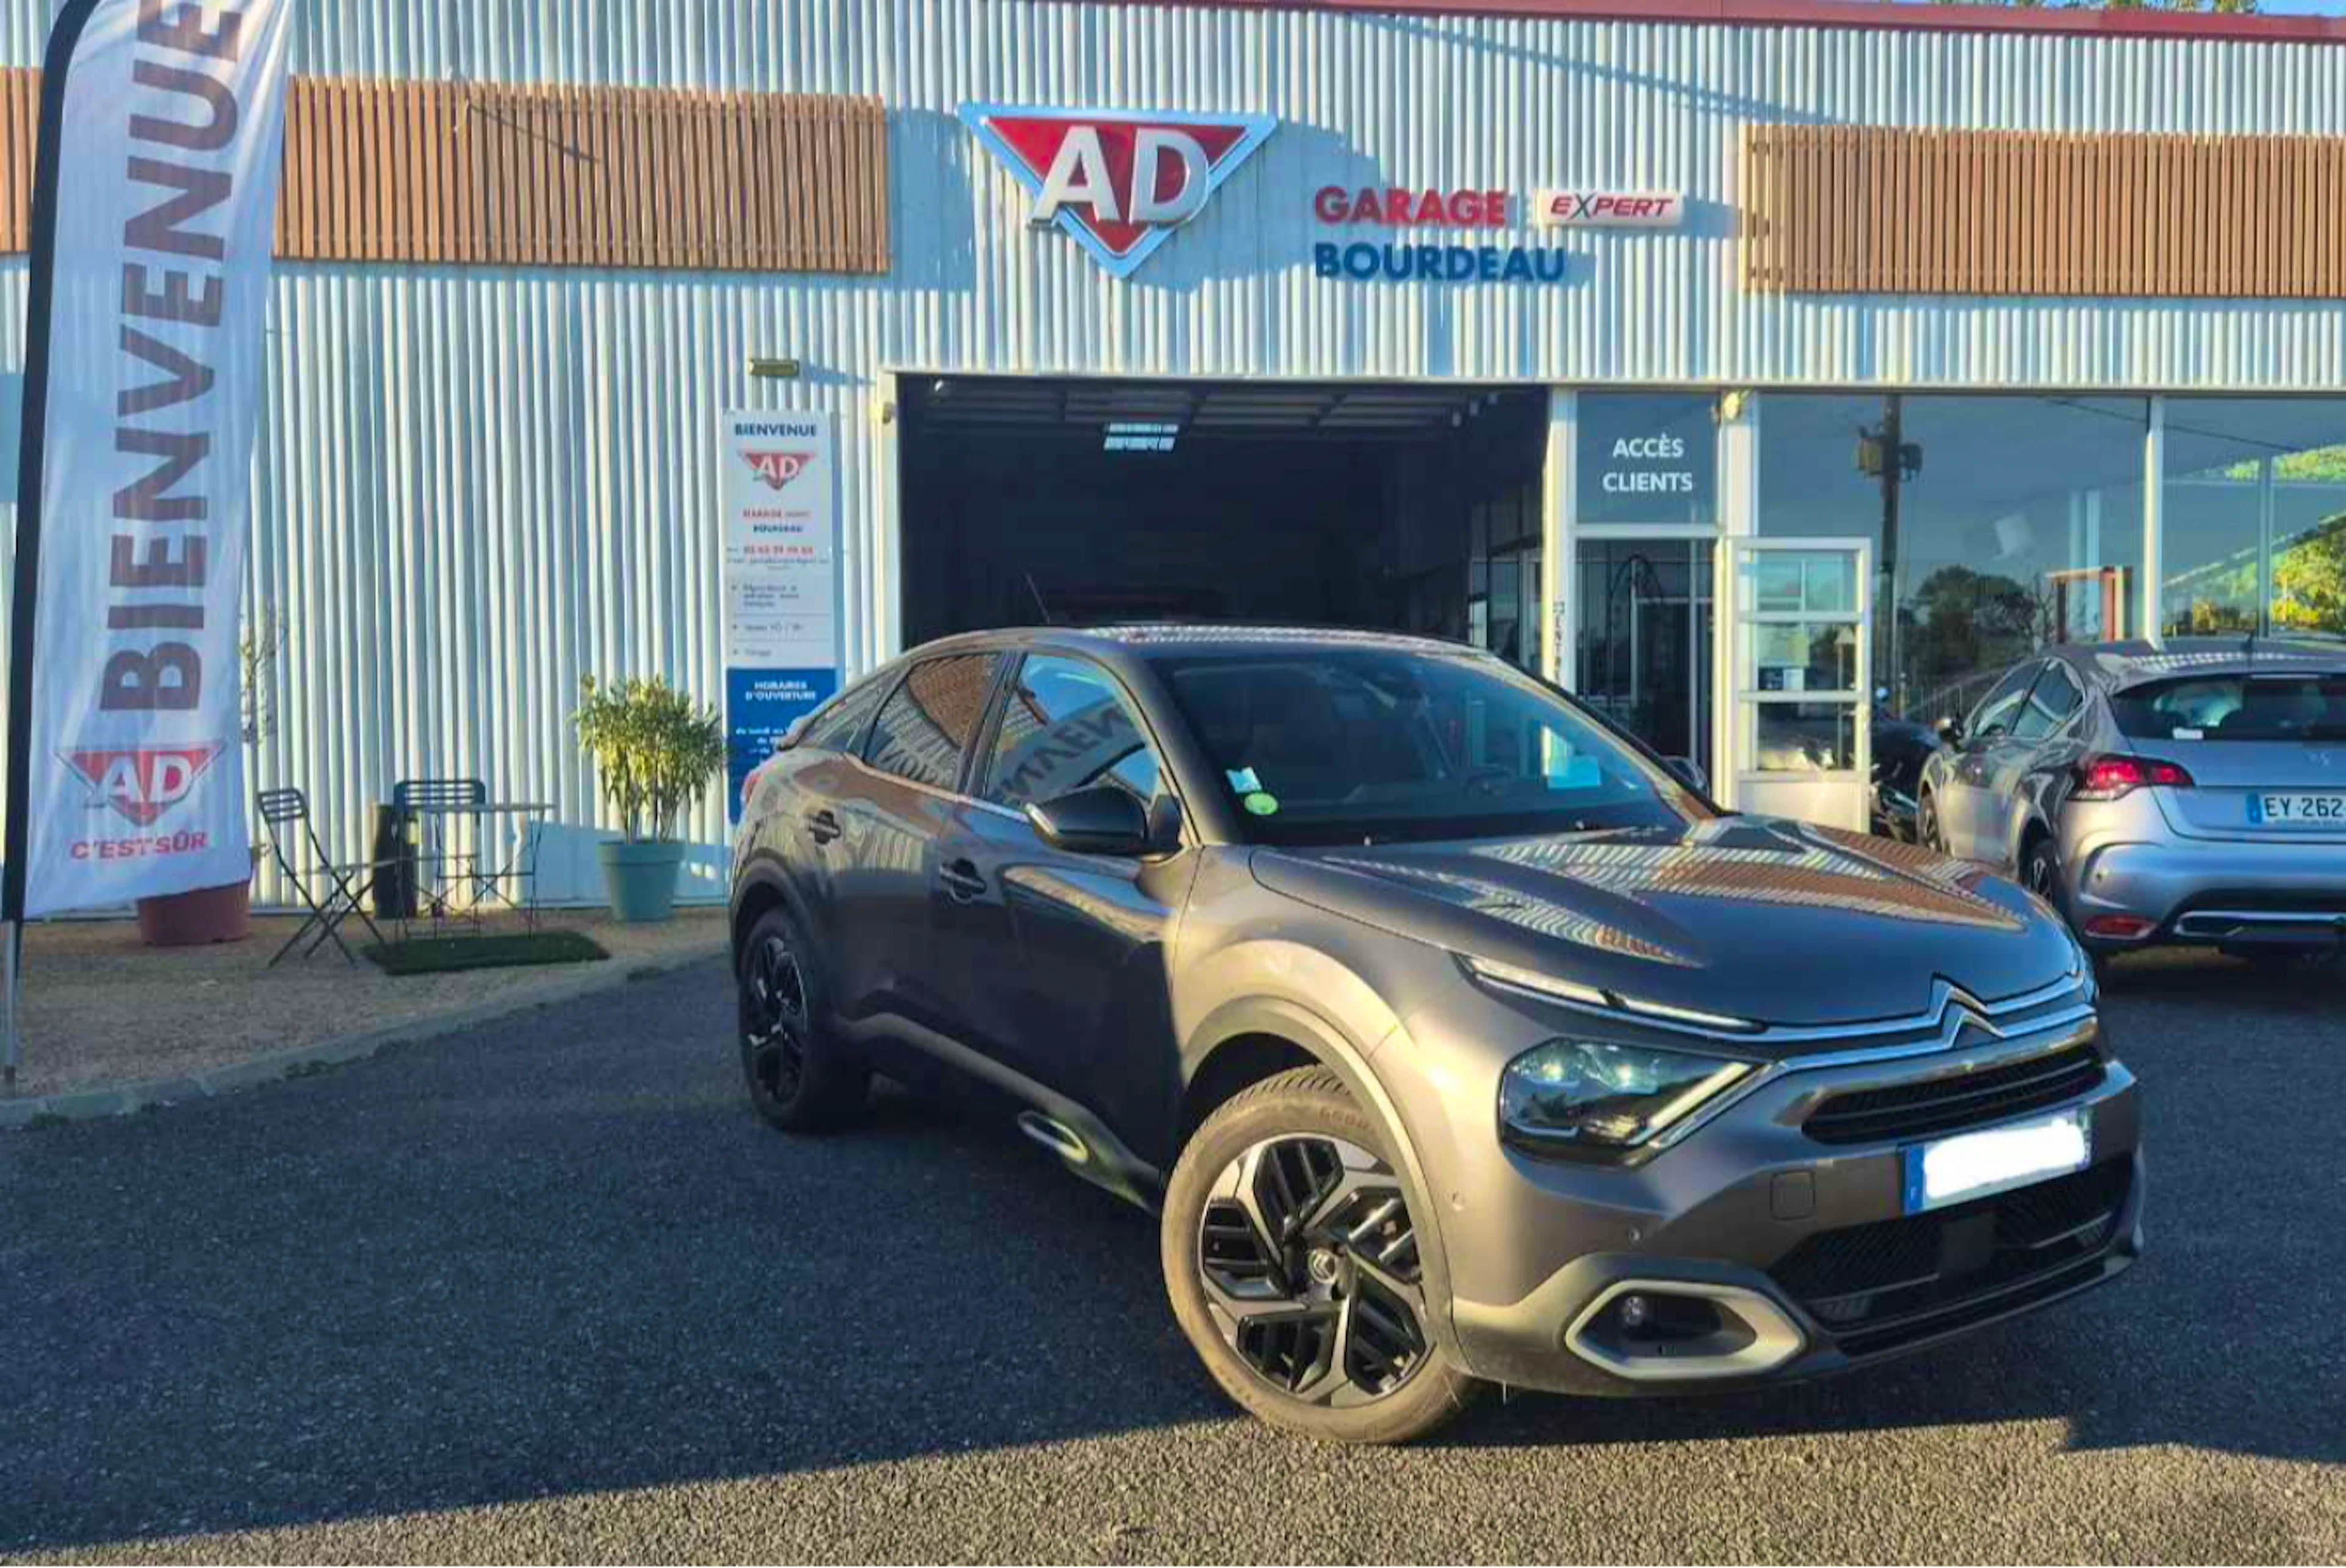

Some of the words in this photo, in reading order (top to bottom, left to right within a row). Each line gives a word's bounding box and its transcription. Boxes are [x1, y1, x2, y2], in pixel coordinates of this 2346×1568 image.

[1028, 125, 1210, 227] AD
[1314, 187, 1507, 227] GARAGE
[1314, 242, 1565, 282] BOURDEAU
[100, 0, 241, 710] BIENVENUE
[735, 423, 816, 436] BIENVENUE
[1612, 433, 1684, 458] ACCÈS
[751, 454, 800, 481] AD
[1602, 472, 1694, 492] CLIENTS
[84, 754, 193, 809] AD
[70, 837, 153, 860] C'EST
[155, 829, 206, 854] SÛR
